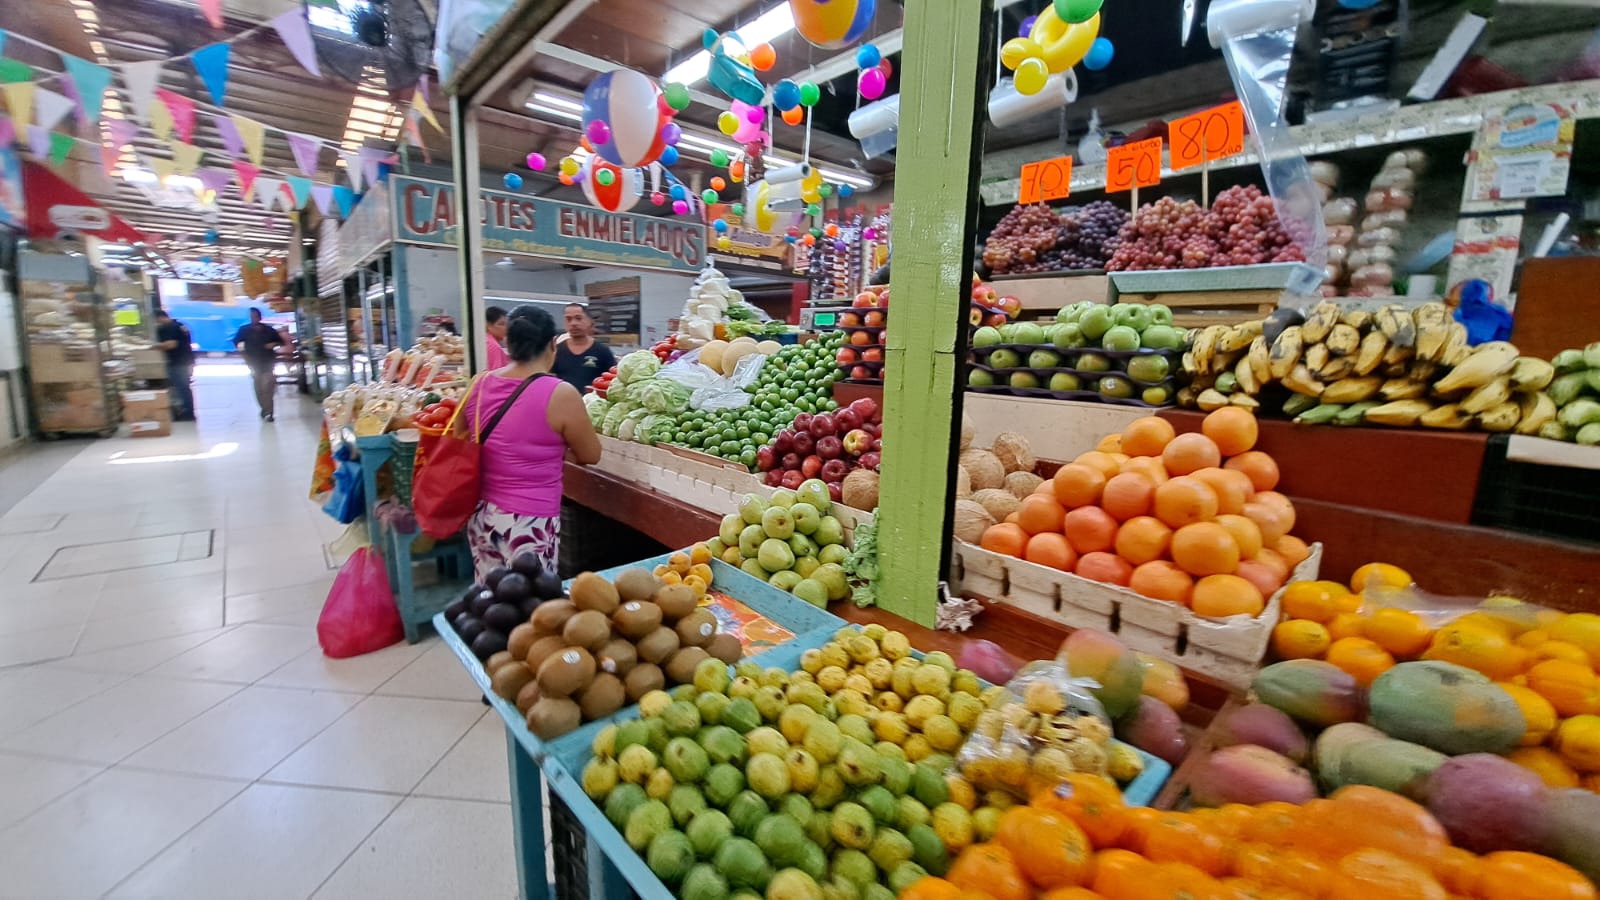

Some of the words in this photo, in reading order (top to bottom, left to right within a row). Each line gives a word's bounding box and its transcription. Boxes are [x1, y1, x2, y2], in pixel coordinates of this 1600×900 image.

[1179, 112, 1229, 160] 80
[1024, 162, 1063, 197] 70
[1115, 152, 1154, 187] 50
[404, 183, 536, 236] CAOTES
[560, 207, 702, 267] ENMIELADOS
